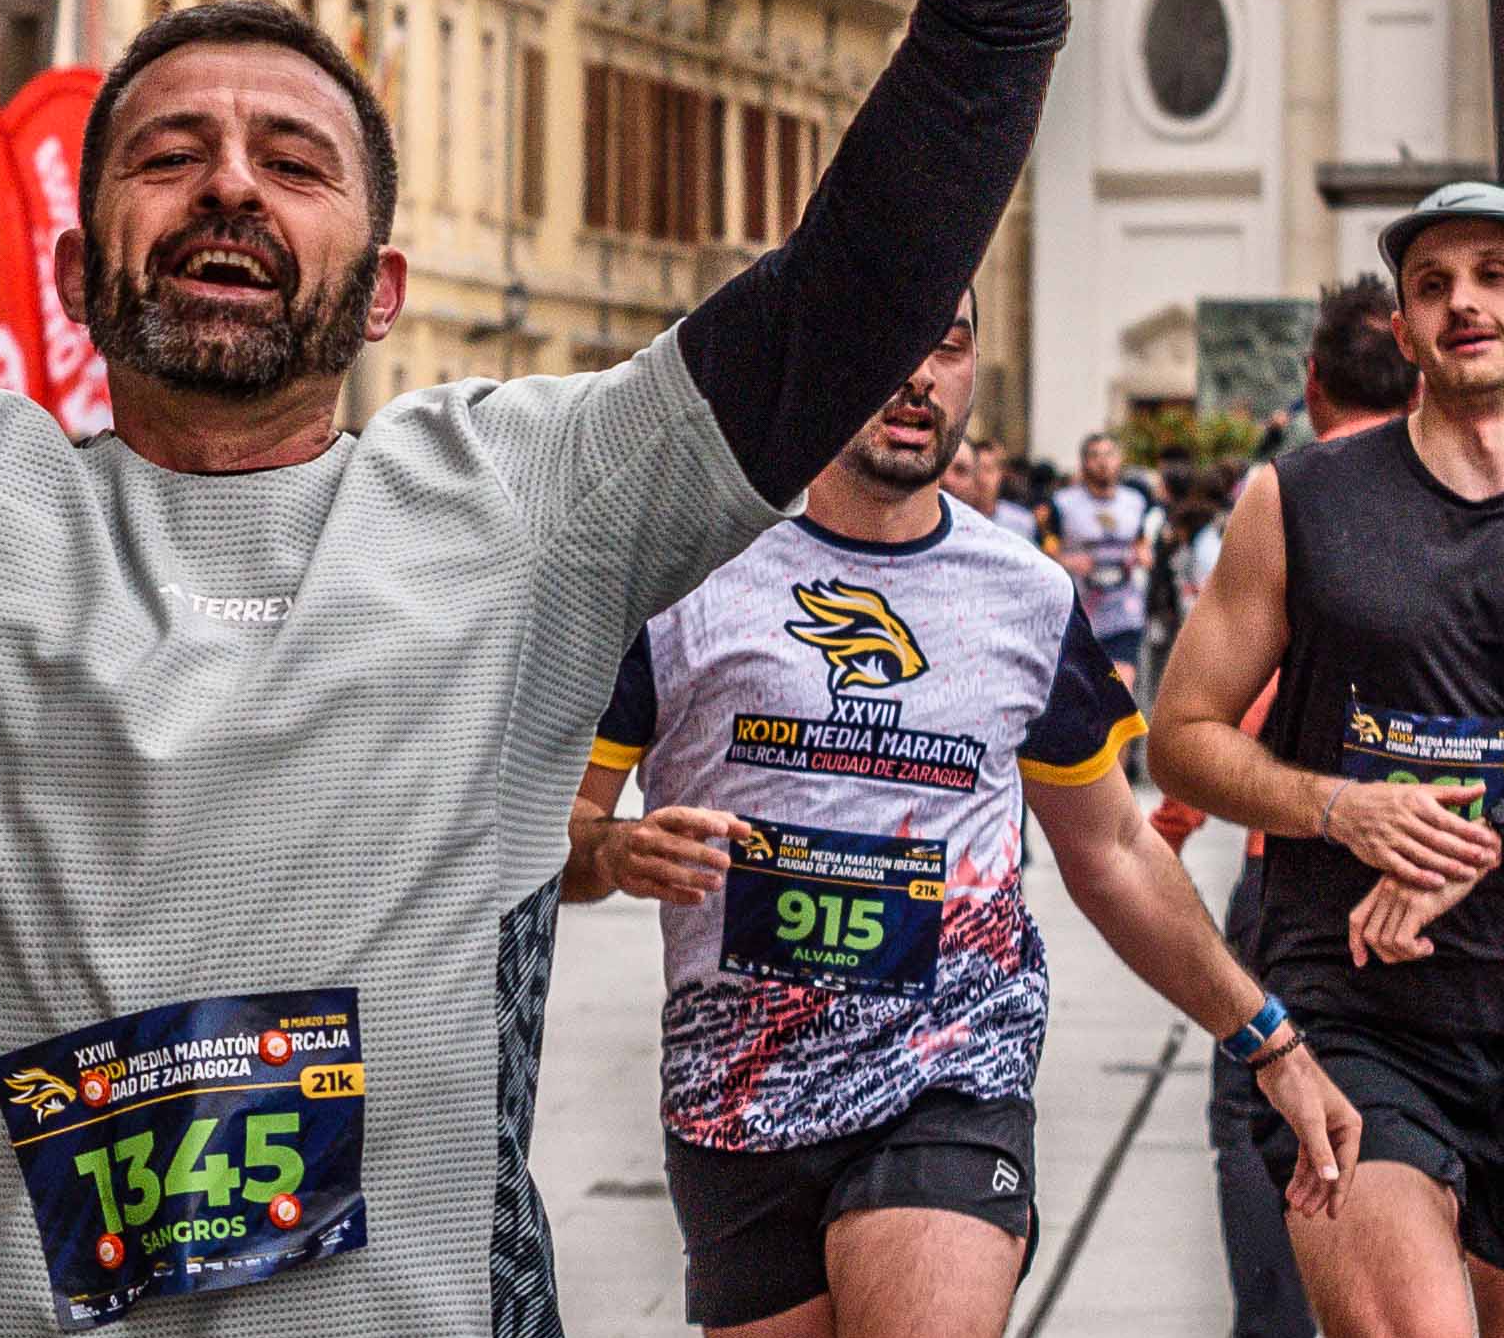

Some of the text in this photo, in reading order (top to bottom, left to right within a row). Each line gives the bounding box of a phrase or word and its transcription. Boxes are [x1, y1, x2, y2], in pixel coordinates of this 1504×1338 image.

[833, 698, 896, 726] XXVII
[737, 719, 981, 769] RODI MEDIA MARATÓN
[810, 751, 872, 775] CIUDAD
[873, 758, 896, 777] DE
[897, 762, 975, 789] ZARAGOZA
[780, 833, 808, 848] XXVII
[777, 857, 886, 881] CIUDAD DE ZARAGOZA
[809, 850, 842, 864] MEDIA
[843, 853, 892, 870] MARATÓN
[893, 859, 941, 874] IBERCAJA
[915, 884, 940, 898] 21k
[775, 890, 885, 951] 915
[792, 947, 859, 968] ALVARO
[74, 1040, 117, 1069] XXVII
[80, 1059, 127, 1080] ODI
[128, 1046, 174, 1075] MEDIA
[173, 1032, 259, 1061] MARATÓN
[140, 1071, 160, 1093] DE
[161, 1057, 252, 1089] ZARAGOZA
[311, 1069, 354, 1093] 21k
[74, 1112, 305, 1235] 1345
[142, 1215, 247, 1255] SANGROS
